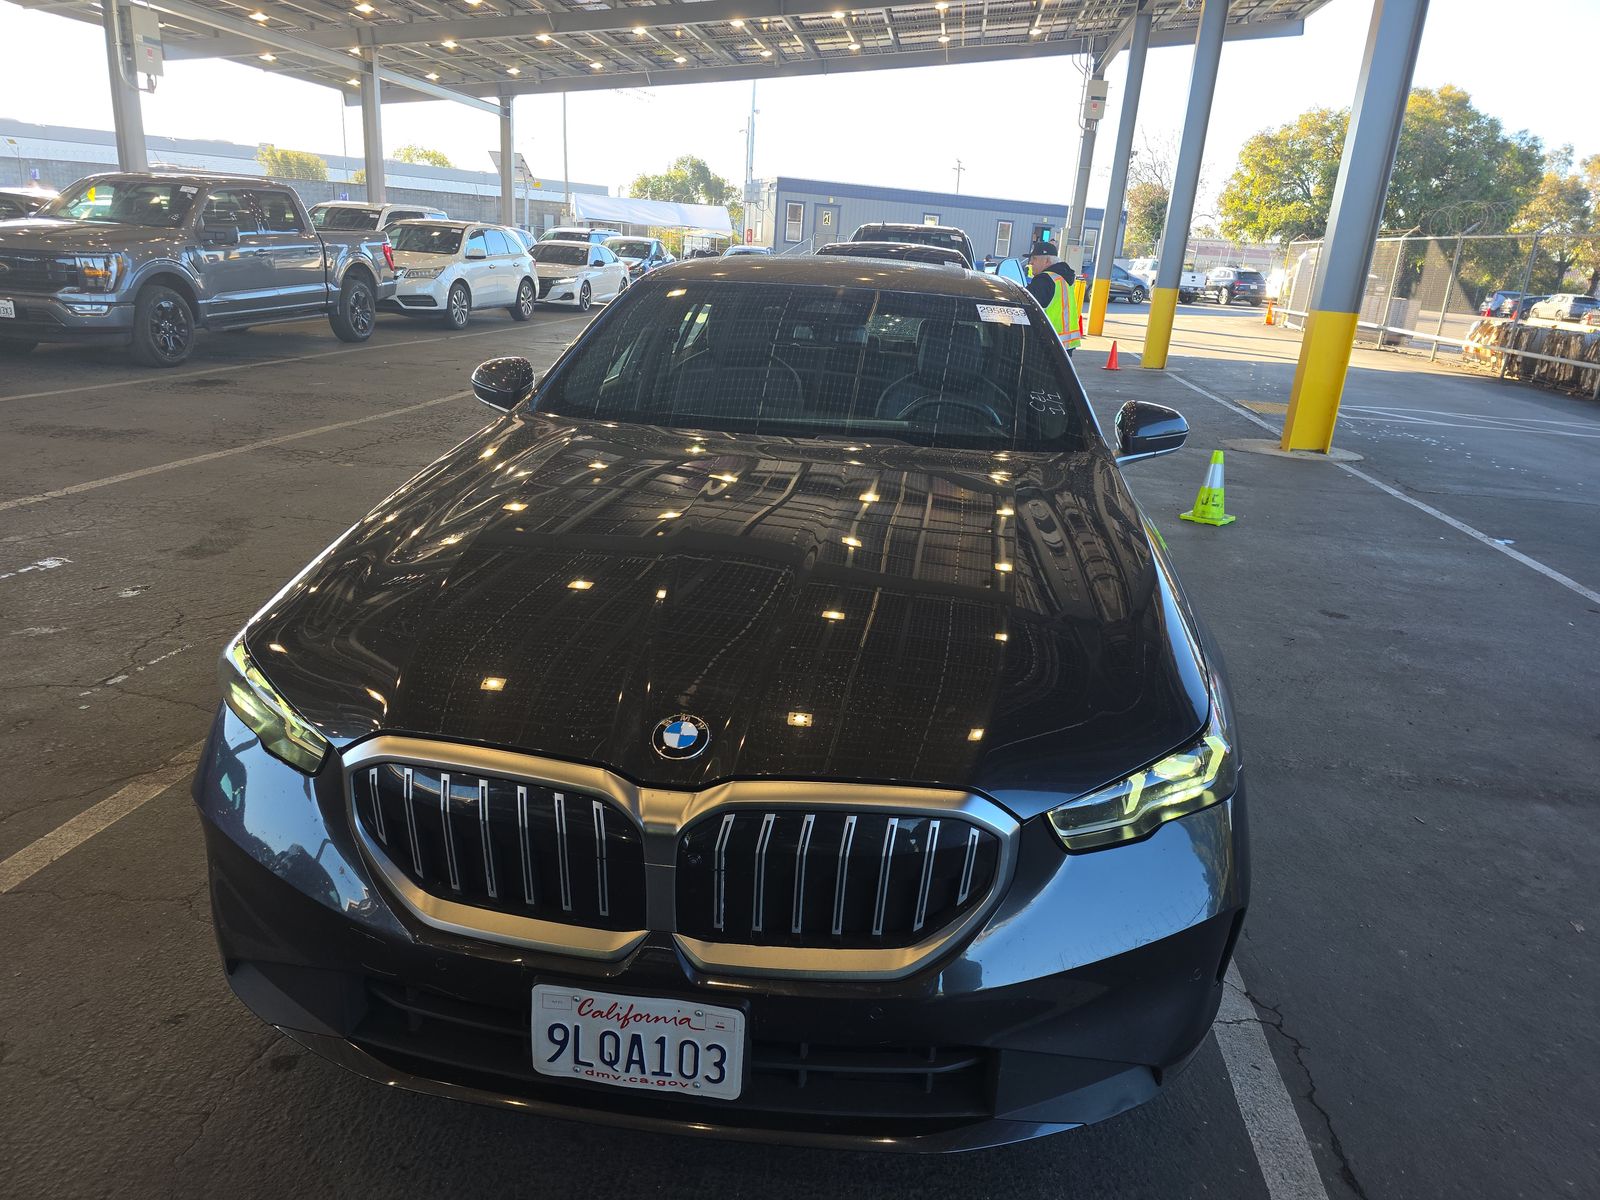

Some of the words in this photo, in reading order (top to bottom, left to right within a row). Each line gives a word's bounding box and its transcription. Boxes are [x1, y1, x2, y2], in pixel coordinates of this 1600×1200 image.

[979, 305, 1027, 317] 2958639
[577, 998, 706, 1030] California
[547, 1022, 727, 1084] 9LQA103
[585, 1069, 689, 1088] dmv.ca.gov
